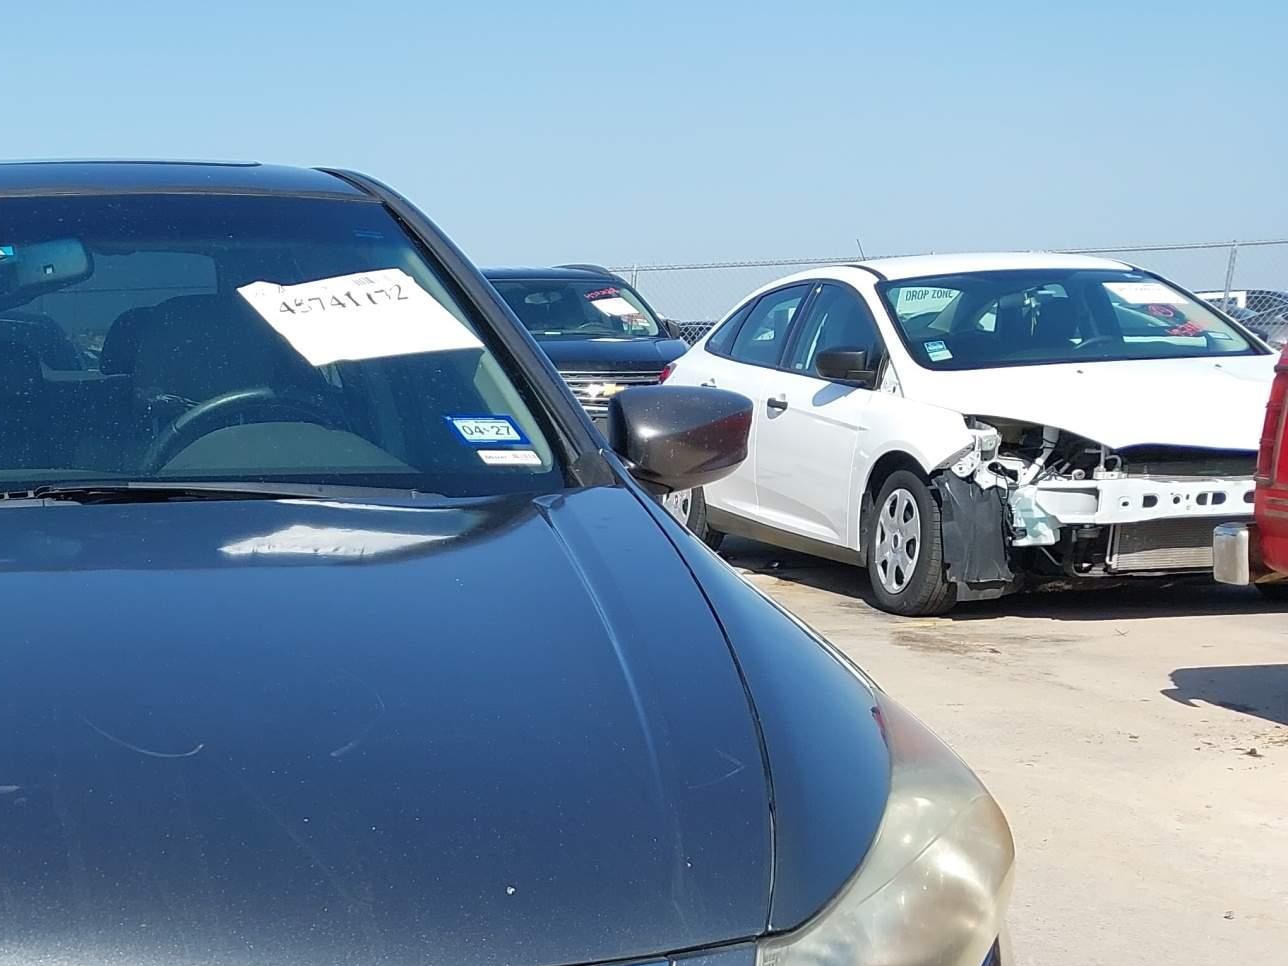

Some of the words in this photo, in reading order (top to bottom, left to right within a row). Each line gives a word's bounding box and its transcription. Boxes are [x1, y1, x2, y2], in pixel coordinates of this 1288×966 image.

[279, 283, 409, 315] 45741172
[905, 289, 930, 302] DROP
[931, 288, 955, 300] ZONE
[461, 424, 512, 437] 04-27
